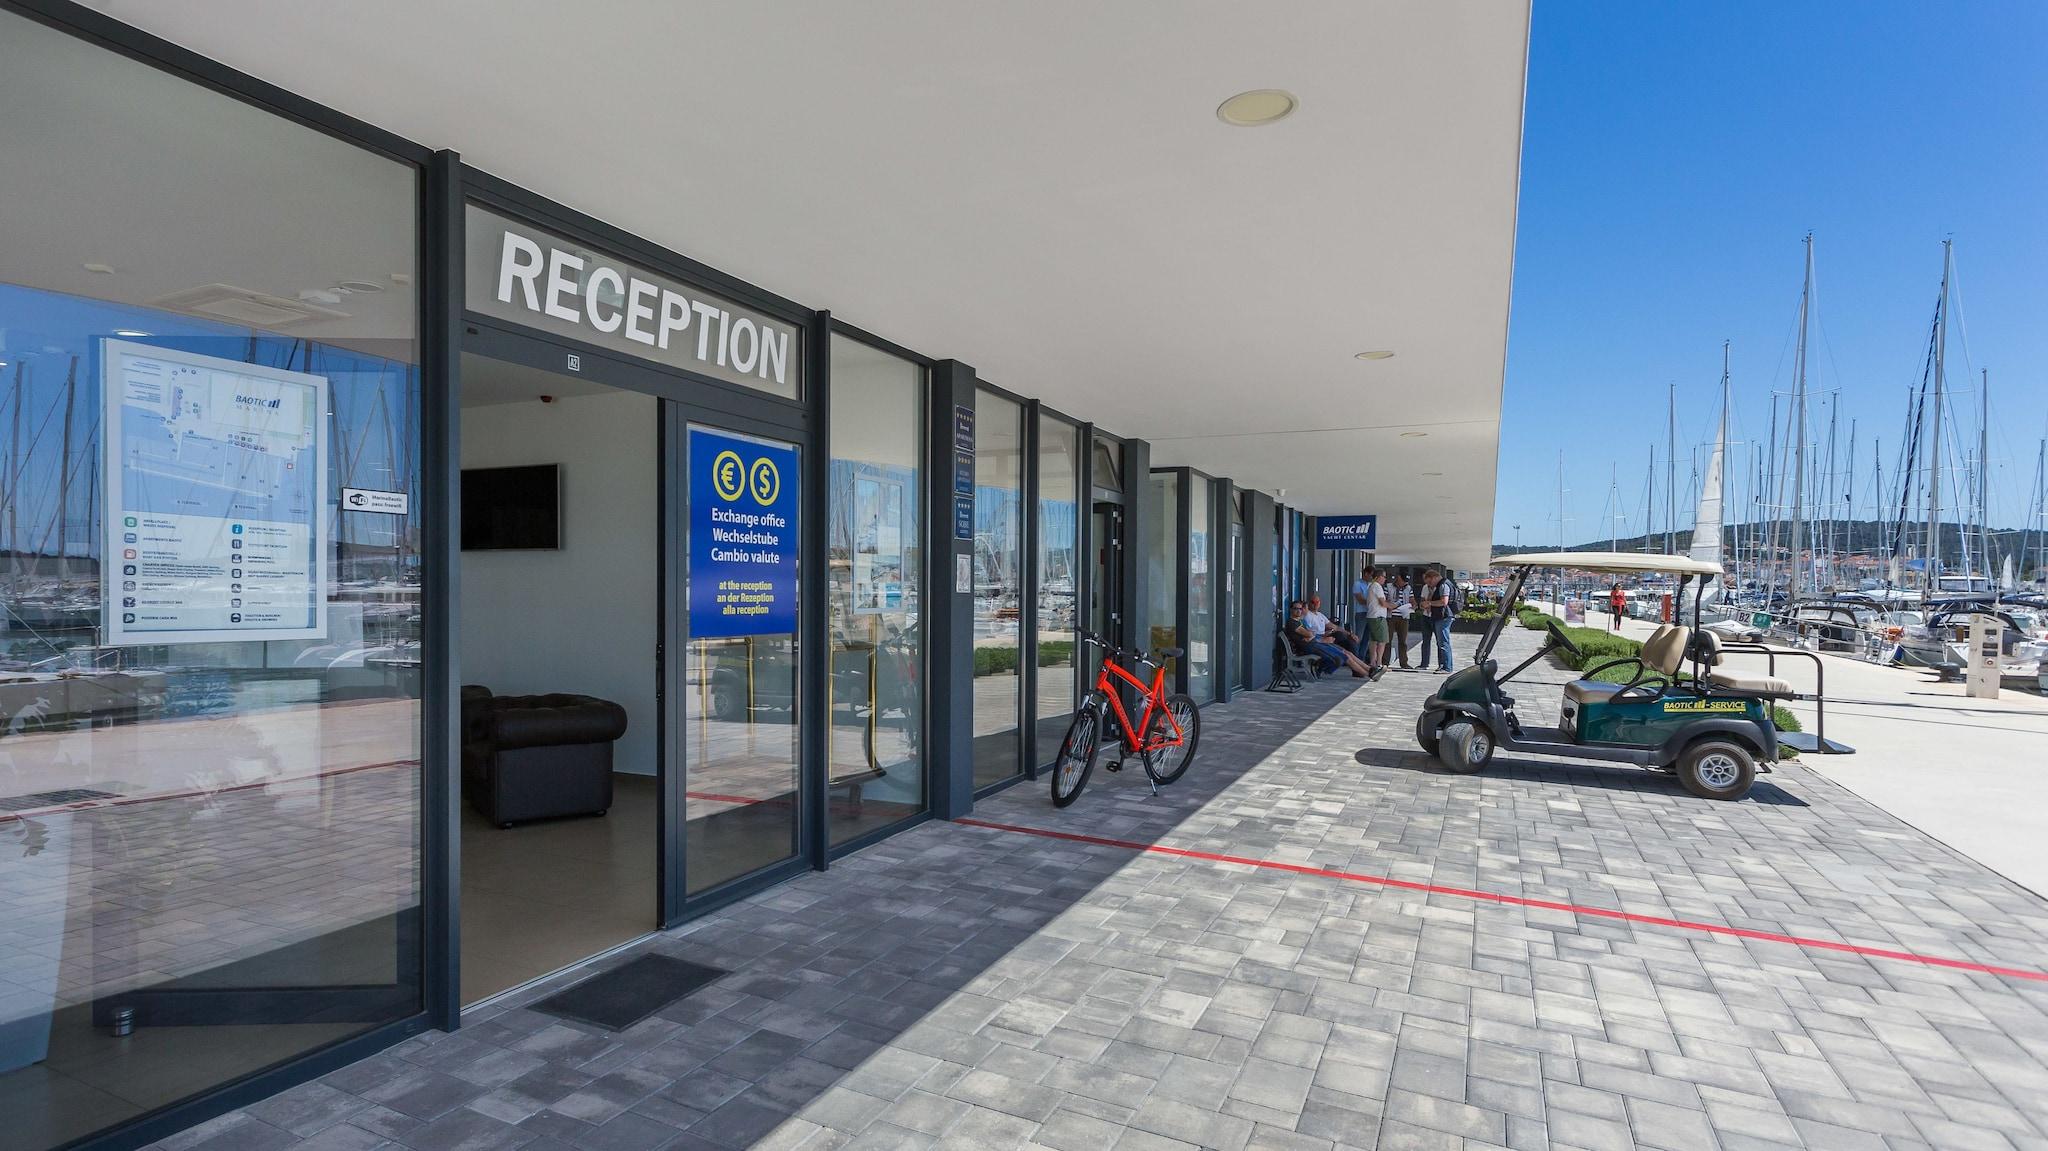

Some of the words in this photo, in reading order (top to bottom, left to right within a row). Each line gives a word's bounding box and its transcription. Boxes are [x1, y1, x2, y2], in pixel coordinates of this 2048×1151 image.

[498, 231, 788, 384] RECEPTION
[711, 507, 759, 528] Exchange
[760, 513, 785, 528] office
[1322, 524, 1356, 534] BAOTIĆ
[713, 528, 779, 545] Wechselstube
[711, 547, 749, 562] Cambio
[751, 550, 780, 564] valute
[719, 581, 727, 590] at
[727, 580, 740, 590] the
[740, 581, 772, 592] reception
[717, 594, 727, 602] an
[727, 592, 739, 602] der
[740, 592, 774, 604] Rezeption
[722, 605, 736, 615] alla
[736, 605, 769, 616] reception
[1738, 612, 1750, 623] B2
